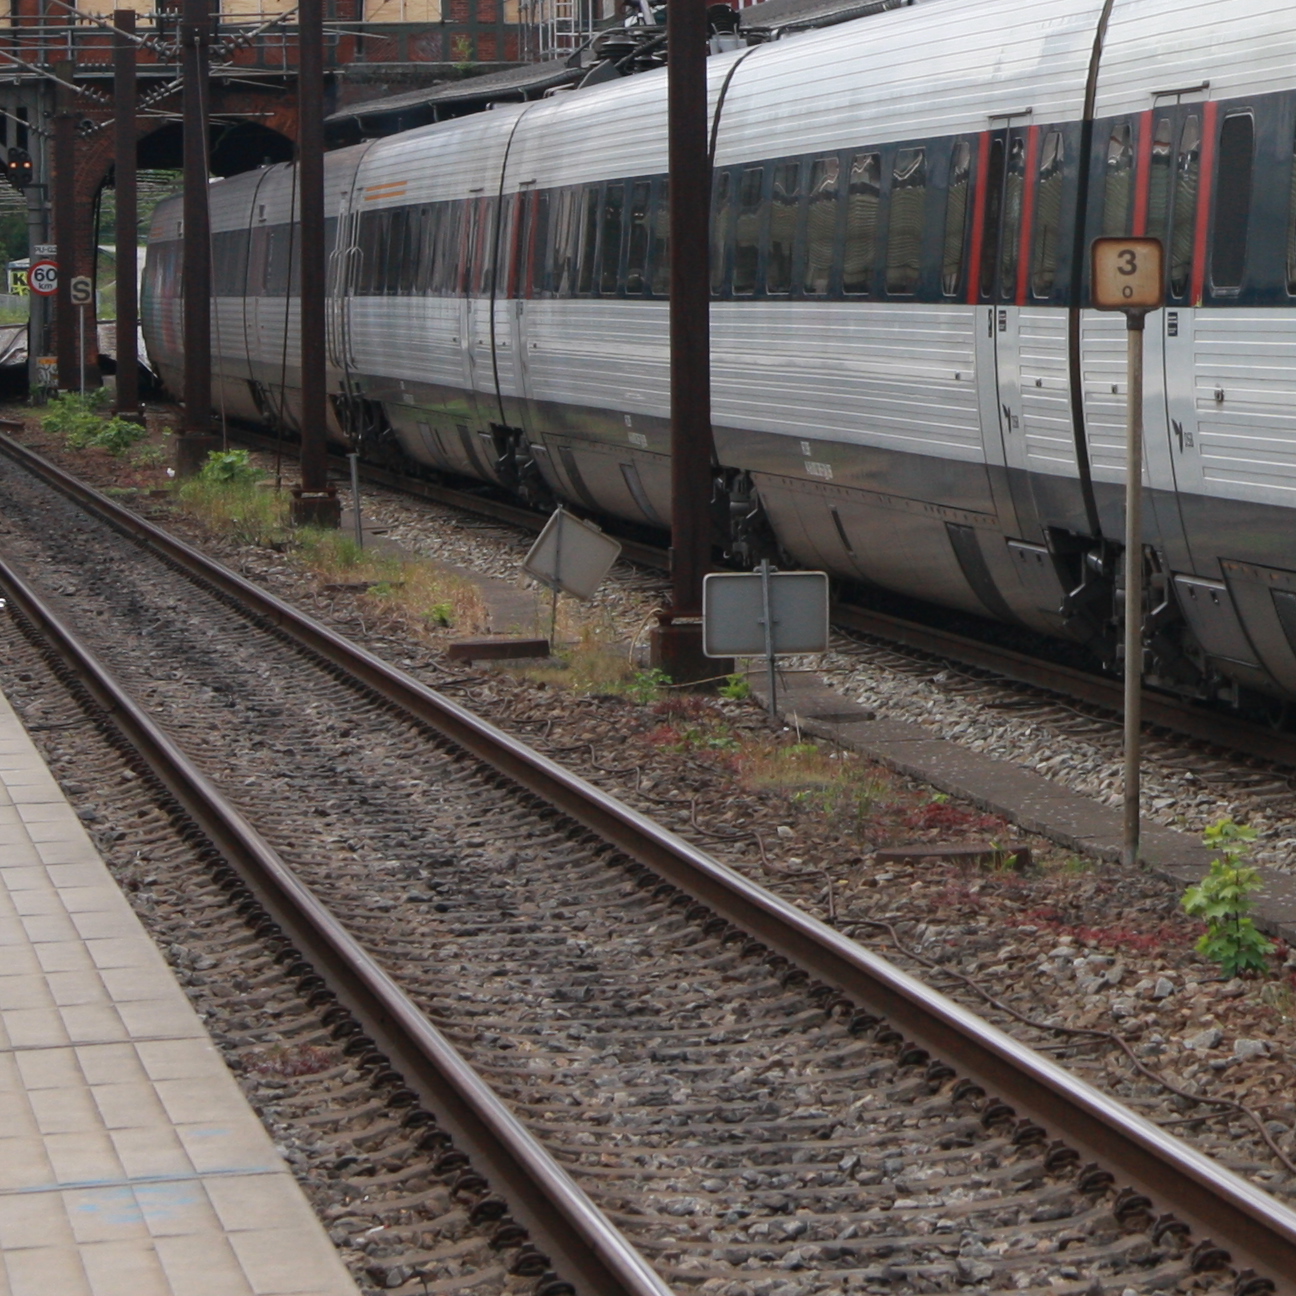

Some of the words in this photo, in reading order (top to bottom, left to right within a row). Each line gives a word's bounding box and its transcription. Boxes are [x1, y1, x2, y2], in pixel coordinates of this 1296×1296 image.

[1117, 249, 1137, 276] 3
[34, 268, 57, 281] 60
[72, 280, 91, 301] S
